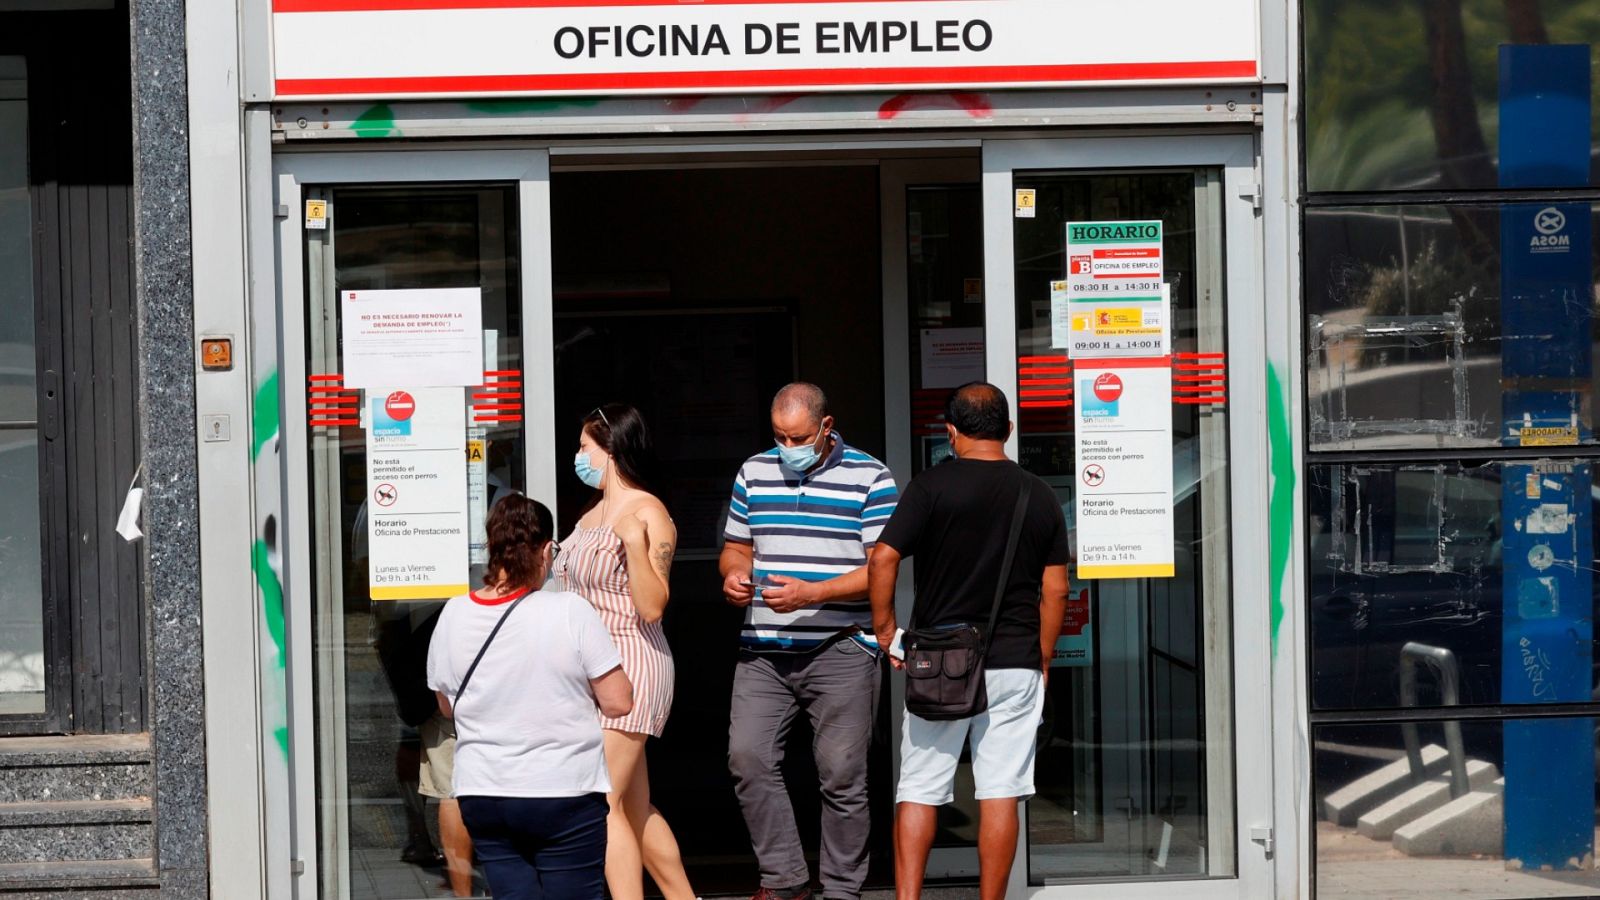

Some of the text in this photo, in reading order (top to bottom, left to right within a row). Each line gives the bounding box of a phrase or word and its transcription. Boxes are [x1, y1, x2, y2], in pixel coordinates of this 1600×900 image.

[553, 19, 993, 59] OFICINA DE EMPLEO
[1073, 226, 1158, 239] HORARIO
[1079, 261, 1091, 273] B
[1073, 283, 1099, 292] 08:30
[1101, 283, 1109, 291] H
[1153, 282, 1160, 290] H
[1083, 319, 1091, 330] 1
[1075, 342, 1101, 350] 09:00
[1127, 341, 1152, 349] 14:00
[1154, 341, 1161, 349] H
[374, 428, 401, 437] espacio
[1081, 447, 1114, 455] permitido
[373, 466, 407, 474] permitido
[1082, 499, 1114, 507] Horario
[1082, 508, 1108, 516] Oficina
[1120, 507, 1166, 515] Prestaciones
[374, 519, 407, 527] Horario
[374, 528, 401, 536] Oficina
[412, 527, 461, 535] Prestaciones
[1082, 544, 1106, 553] Lunes
[1113, 543, 1142, 551] Viernes
[1082, 553, 1094, 562] De
[1095, 553, 1101, 561] 9
[1102, 552, 1110, 561] h.
[1118, 552, 1128, 561] 14
[1129, 552, 1137, 561] h.
[375, 565, 399, 573] Lunes
[407, 564, 436, 572] Viernes
[375, 574, 388, 583] De
[388, 574, 394, 582] 9
[395, 574, 403, 582] h.
[422, 573, 431, 581] h.
